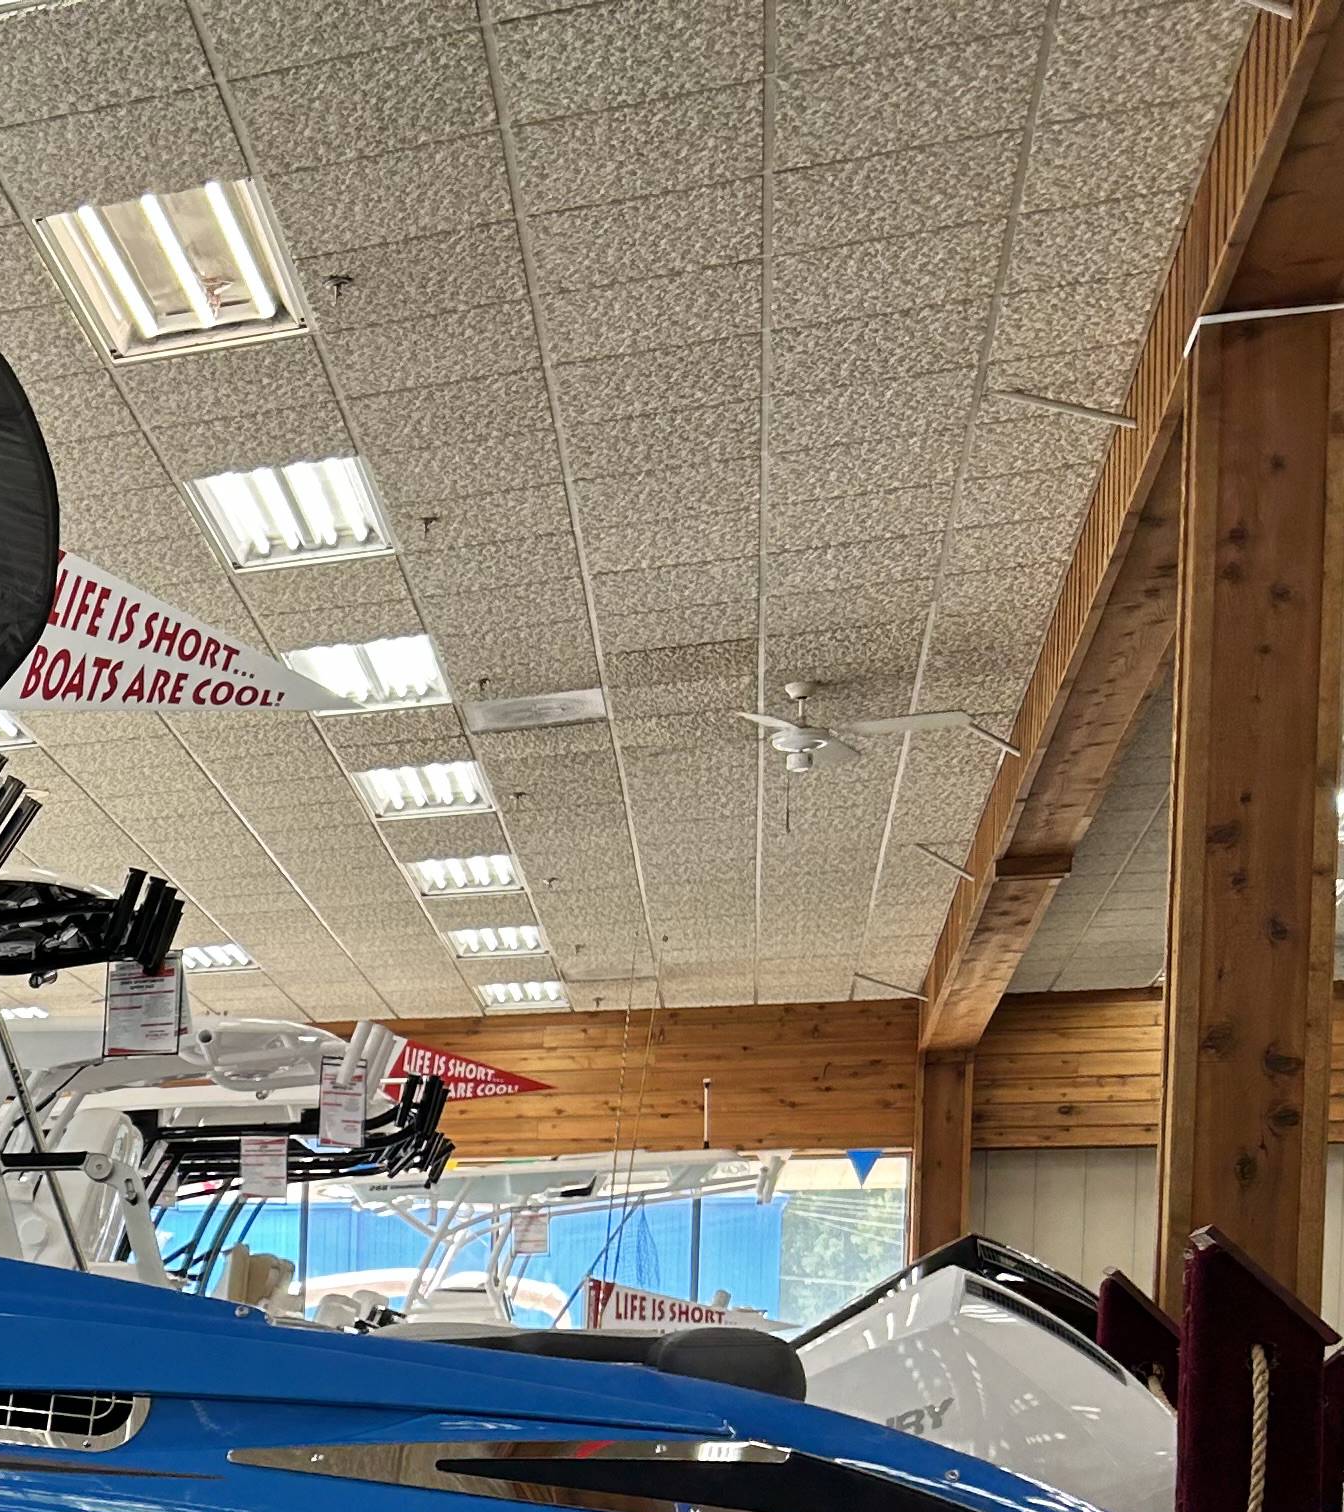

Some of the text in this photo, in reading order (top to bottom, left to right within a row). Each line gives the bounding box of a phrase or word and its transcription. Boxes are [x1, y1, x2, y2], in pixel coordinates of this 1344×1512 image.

[47, 569, 255, 679] LIFE IS SHORT...
[20, 644, 285, 707] BOATS ARE COOL!
[403, 1046, 431, 1075] LIFE
[433, 1054, 446, 1076] IS
[447, 1082, 473, 1100] ARE
[615, 1291, 646, 1321] LIFE
[652, 1298, 665, 1322] IS
